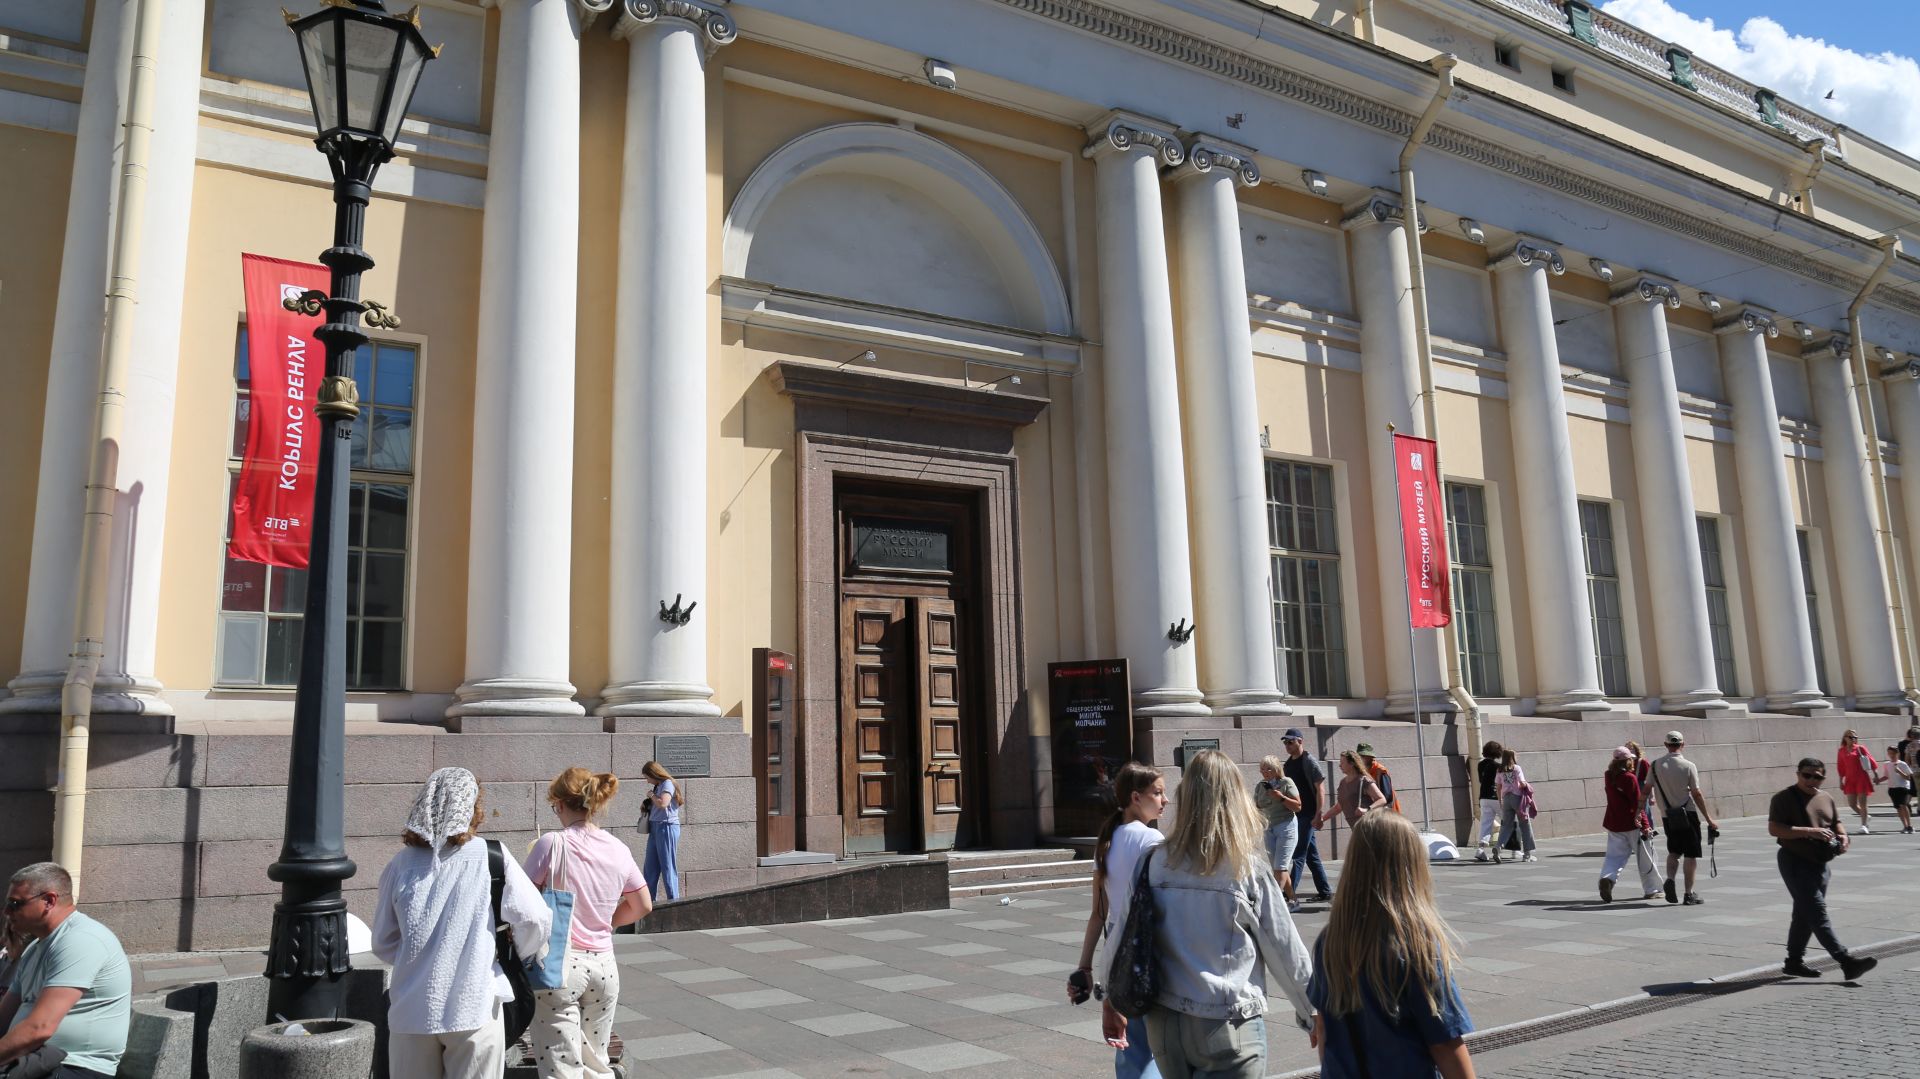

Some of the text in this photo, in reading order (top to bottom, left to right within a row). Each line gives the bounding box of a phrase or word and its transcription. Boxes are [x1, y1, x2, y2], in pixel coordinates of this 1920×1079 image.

[1414, 481, 1430, 589] РУССКИЙ МУЗЕЙ
[873, 533, 933, 549] РУССКИЙ
[883, 547, 925, 559] МУЗЕЙ
[1066, 705, 1114, 713] ОБЩЕРОССИЙСКАЯ
[1079, 712, 1102, 720] МИНУТА
[1075, 719, 1107, 728] МОЛЧАНИЯ
